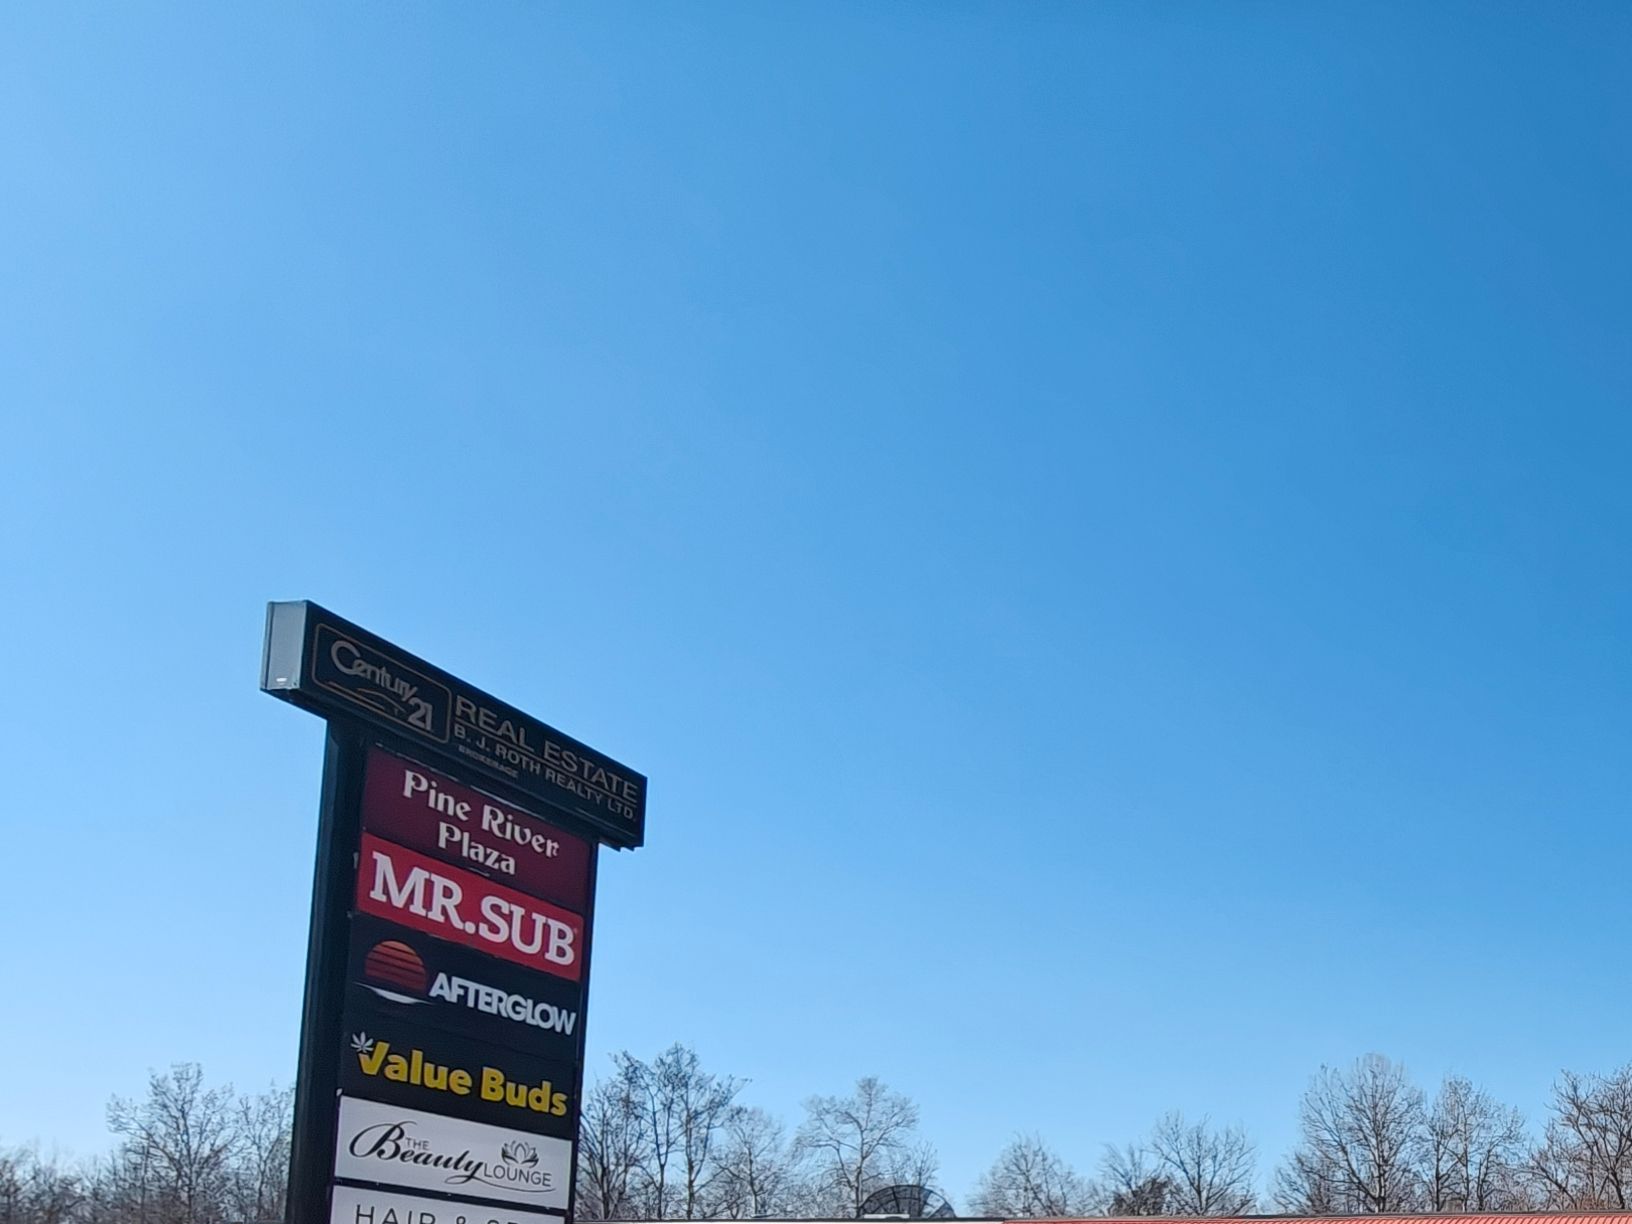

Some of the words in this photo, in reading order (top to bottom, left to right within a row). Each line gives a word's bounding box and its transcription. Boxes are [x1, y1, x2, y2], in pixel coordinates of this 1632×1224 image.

[331, 640, 418, 701] Century
[408, 697, 432, 730] 21
[454, 723, 472, 743] B.
[476, 736, 491, 751] J.
[496, 744, 541, 774] ROTH
[545, 767, 601, 804] REALTY
[607, 799, 636, 822] LTD.
[455, 695, 535, 752] REAL
[544, 740, 638, 803] ESTATE
[403, 769, 471, 821] Pine
[482, 804, 560, 858] River
[437, 822, 516, 875] Plaza
[369, 851, 576, 966] MR.SUB
[429, 972, 576, 1036] AFTERGLOW
[358, 1041, 473, 1096] Value
[480, 1066, 568, 1117] Buds
[349, 1121, 486, 1185] Beauty
[483, 1162, 553, 1188] LOUNGE
[404, 1136, 430, 1151] THE
